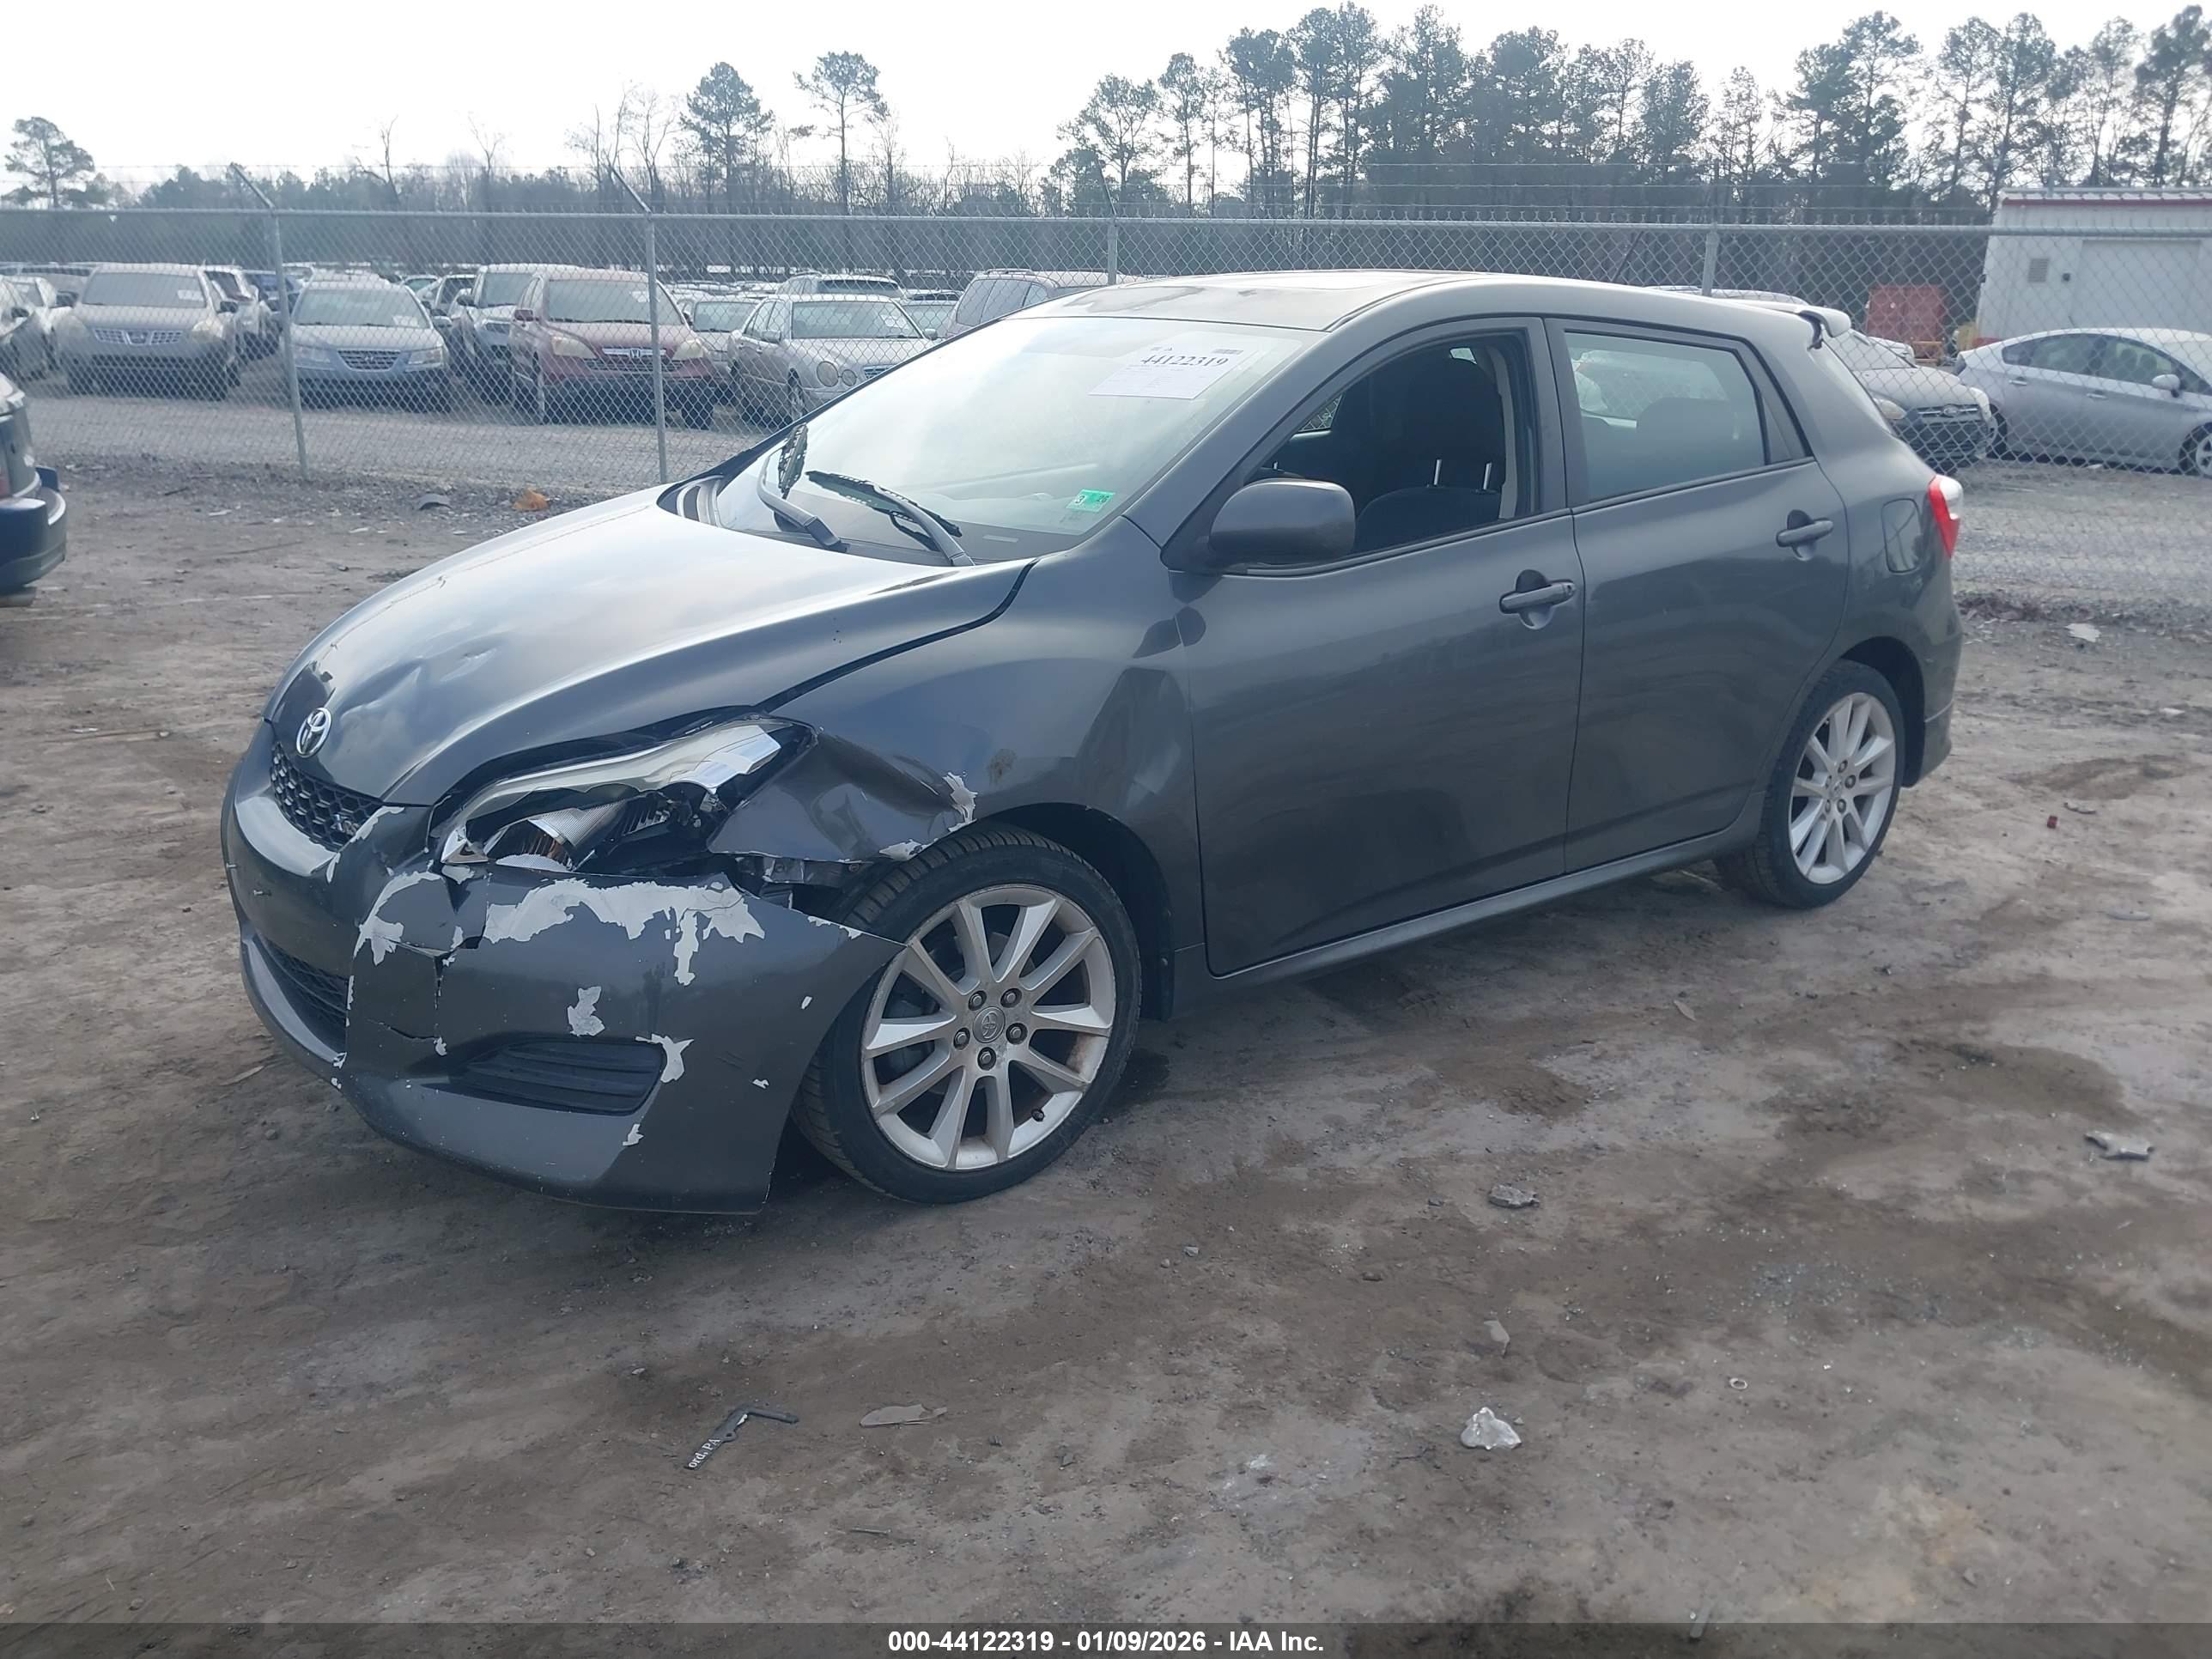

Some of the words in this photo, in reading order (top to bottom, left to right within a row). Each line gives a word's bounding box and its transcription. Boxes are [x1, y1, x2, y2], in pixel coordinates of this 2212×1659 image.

[1140, 354, 1229, 367] 44122319
[1075, 495, 1085, 504] 3
[702, 1438, 721, 1451] PA
